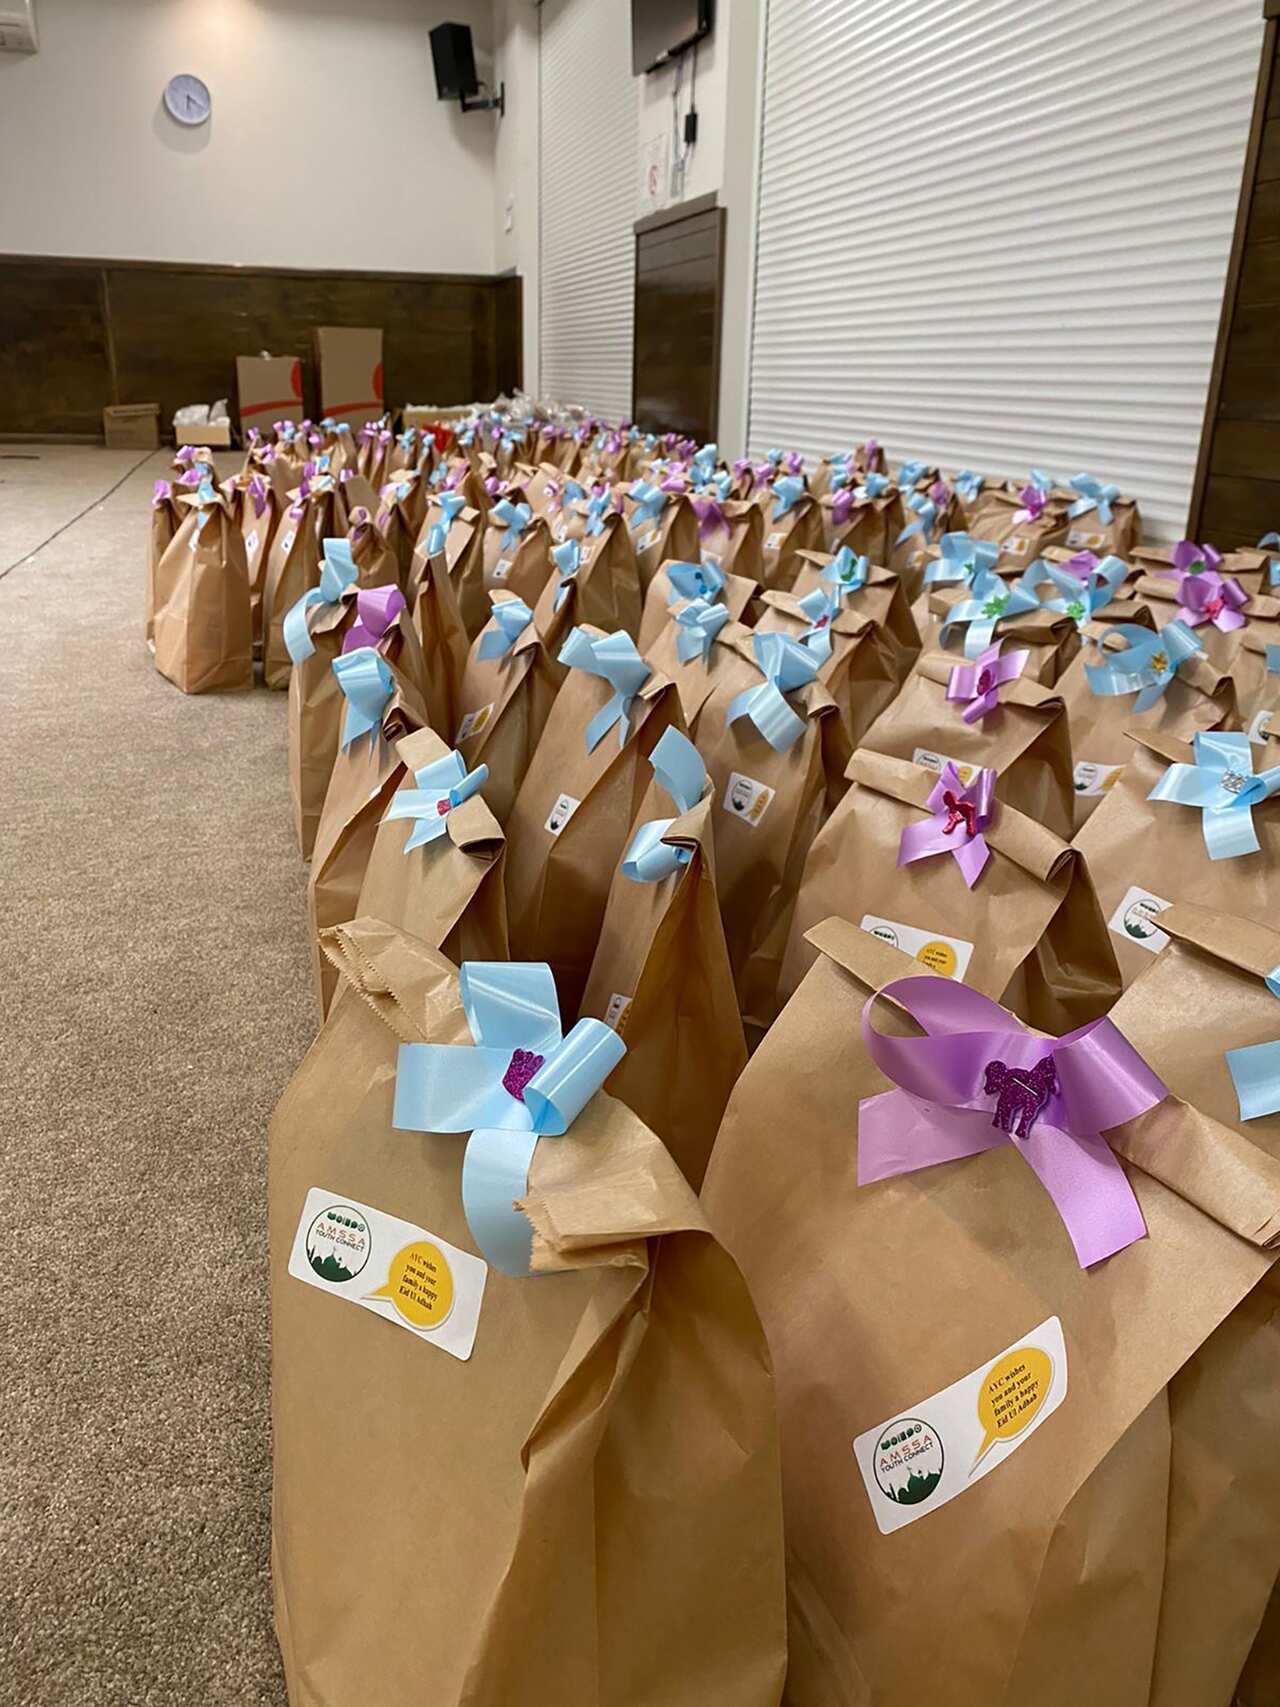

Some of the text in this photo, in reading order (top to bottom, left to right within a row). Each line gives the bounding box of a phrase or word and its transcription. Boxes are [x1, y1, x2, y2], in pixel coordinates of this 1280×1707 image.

[316, 1229, 364, 1252] YOUTH CONNECT
[317, 1222, 366, 1246] AMSSA
[405, 1264, 437, 1285] you and your
[423, 1260, 437, 1272] wishes
[399, 1285, 410, 1297] Eid
[402, 1274, 419, 1290] family
[422, 1286, 438, 1301] happy
[1005, 1364, 1026, 1381] wishes
[991, 1372, 1031, 1407] you and your
[994, 1399, 1014, 1416] family
[1020, 1380, 1039, 1399] happy
[997, 1414, 1008, 1428] Eid
[880, 1434, 931, 1466] AMSSA
[881, 1441, 934, 1473] YOUTH CONNECT
